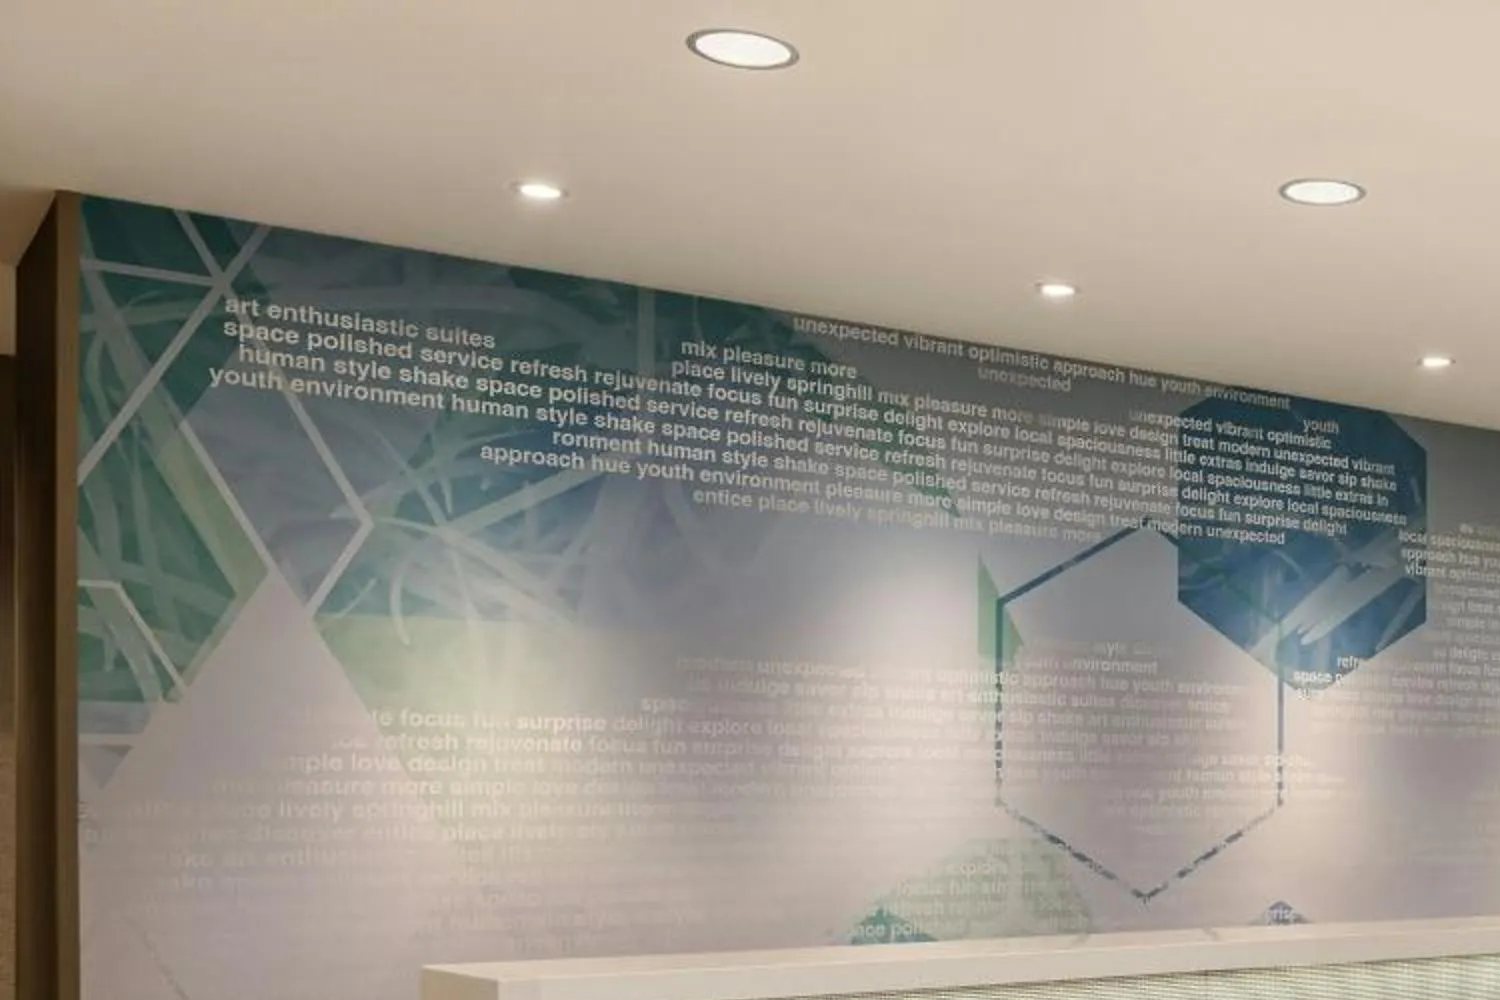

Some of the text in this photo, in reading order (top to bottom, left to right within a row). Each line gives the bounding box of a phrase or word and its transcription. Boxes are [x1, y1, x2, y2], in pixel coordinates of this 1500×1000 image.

[223, 296, 497, 350] art enthusiastic suites
[679, 339, 858, 380] mix pleasure more
[791, 316, 1292, 410] unexpected vibrant optimistic approach hue youth environment
[221, 320, 1398, 492] space polished service refresh rejuvenate focus fun surprise delight explore local spaciousness little extras indulge savor sip shake
[237, 342, 326, 373] human
[331, 357, 392, 383] style
[398, 365, 468, 391] shake
[474, 376, 542, 400] space
[547, 386, 640, 412] polished
[644, 399, 720, 422] service
[722, 408, 793, 432] refresh
[796, 417, 894, 444] rejuvenate
[896, 428, 946, 451] focus
[949, 435, 978, 455] fun
[981, 442, 1049, 464] surprise
[1052, 449, 1107, 473] delight
[1109, 459, 1166, 479] explore
[1167, 464, 1204, 483] local
[1205, 472, 1301, 496] spaciousness
[1302, 481, 1332, 500] little
[1333, 488, 1374, 505] extras
[669, 358, 726, 382] place
[729, 365, 780, 394] lively
[785, 376, 872, 403] springhill
[876, 388, 911, 407] mix
[912, 393, 988, 418] pleasure
[990, 406, 1034, 425] more
[1092, 417, 1126, 437] love
[1127, 422, 1179, 447] design
[1181, 431, 1214, 450] treat
[1217, 438, 1271, 458] modern
[1272, 446, 1350, 469] unexpected
[1350, 456, 1396, 475] vibrant
[1128, 408, 1213, 432] unexpected
[1214, 419, 1264, 439] vibrant
[1301, 417, 1340, 434] youth
[207, 366, 1408, 525] youth environment human style shake space polished service refresh rejuvenate focus fun surprise delight explore local spaciousness
[479, 444, 1286, 545] approach hue youth environment pleasure more simple love design treat modern unexpected
[551, 430, 1348, 537] ronment human style shake space polished service refresh rejuvenate focus fun surprise delight
[690, 488, 754, 509] entice
[756, 493, 810, 515] place
[813, 498, 862, 524] lively
[399, 707, 466, 728] focus
[514, 712, 607, 735] surprise
[464, 732, 582, 756] rejuvenate
[349, 752, 402, 772] love
[406, 753, 488, 778] design
